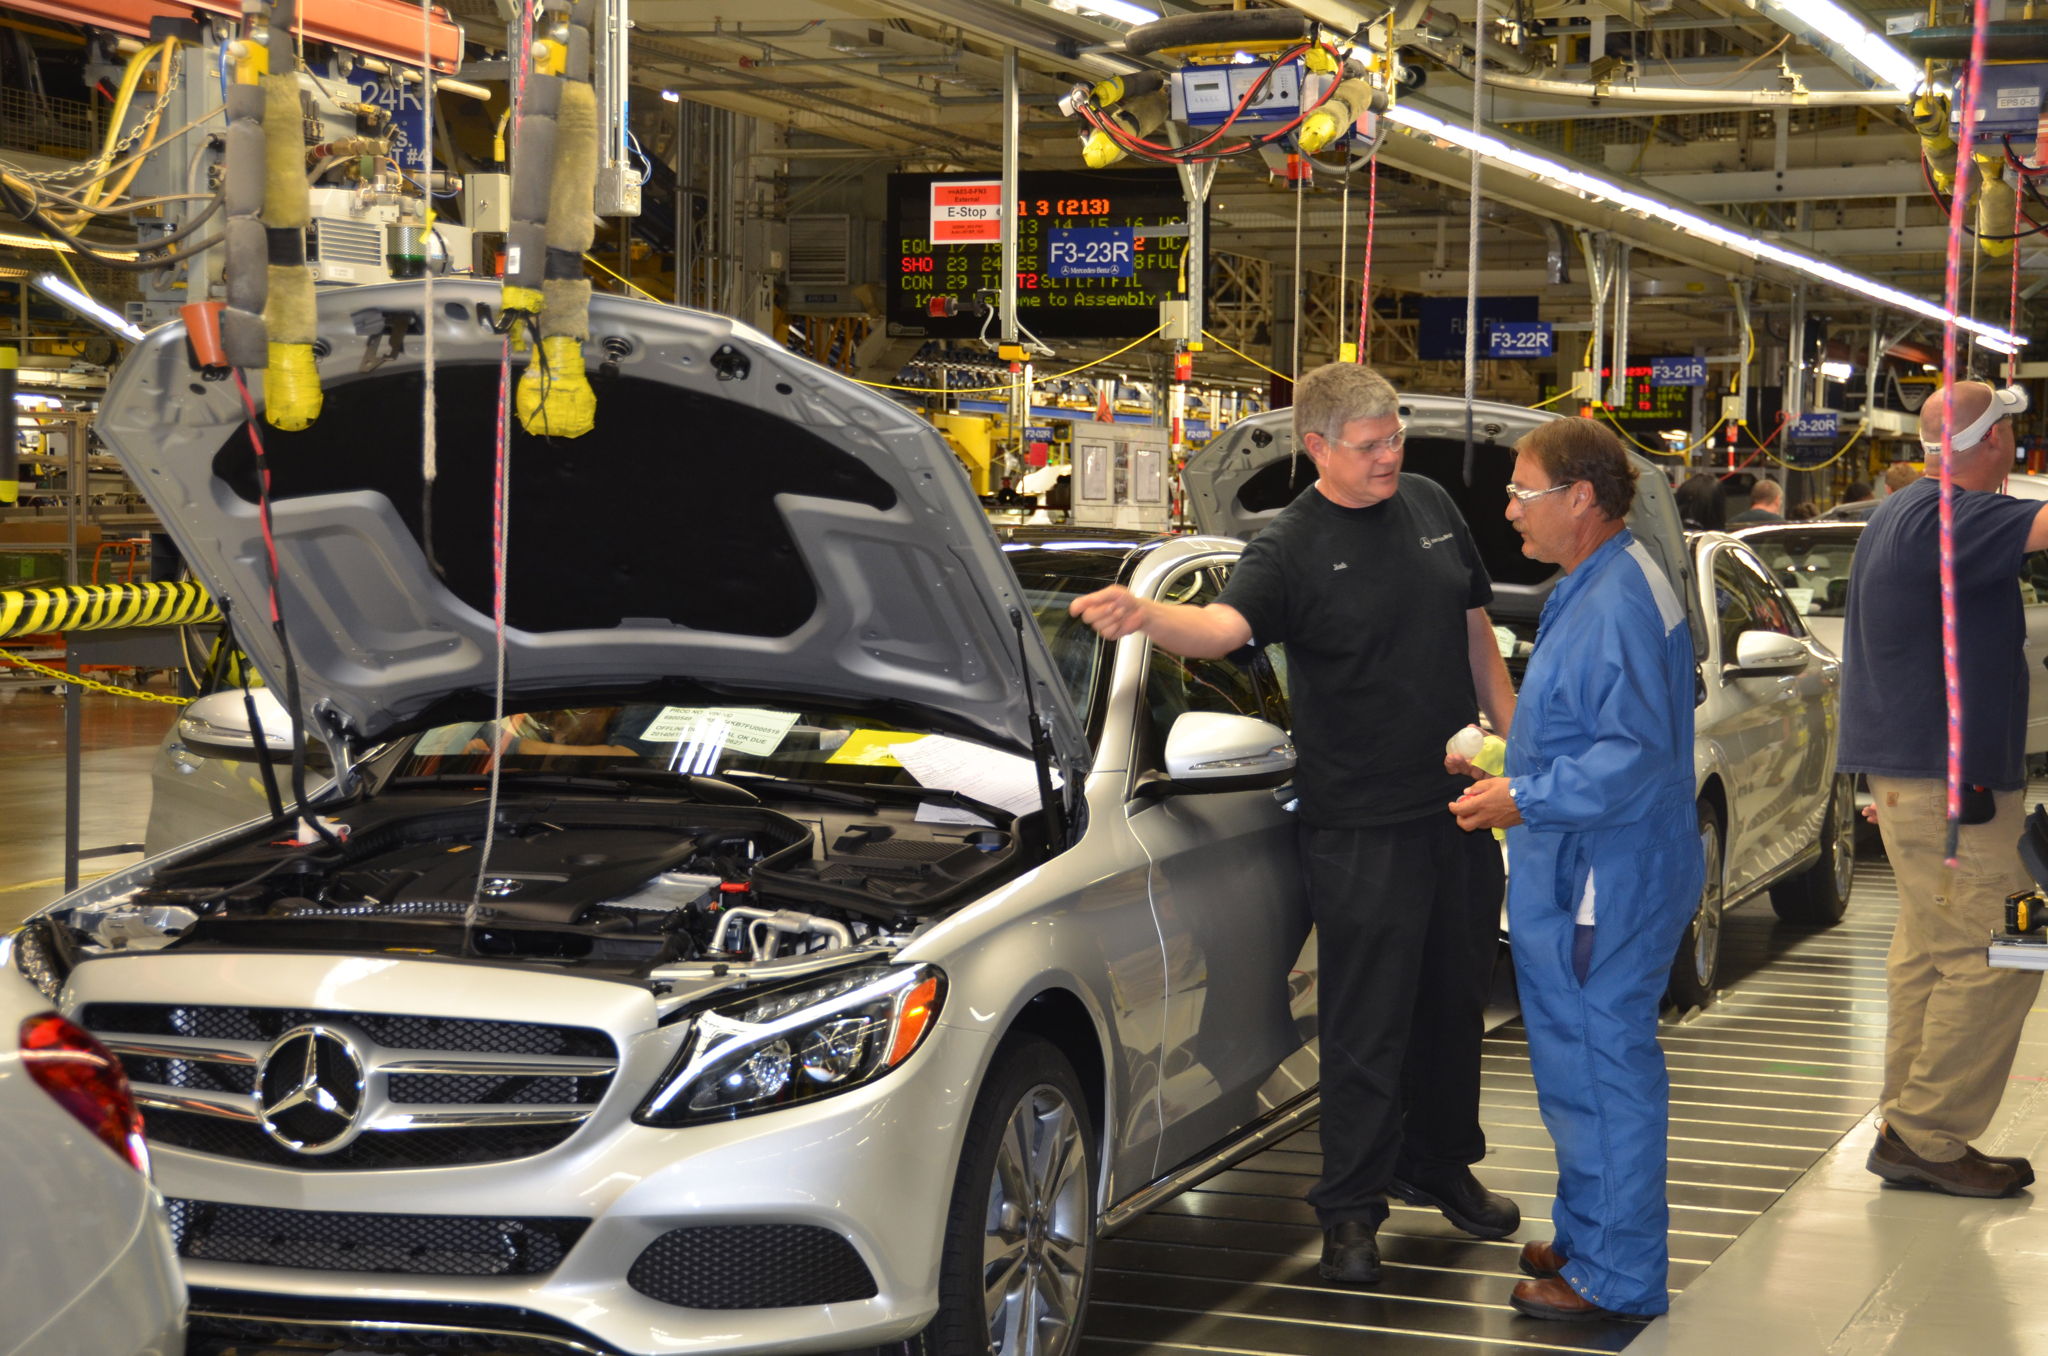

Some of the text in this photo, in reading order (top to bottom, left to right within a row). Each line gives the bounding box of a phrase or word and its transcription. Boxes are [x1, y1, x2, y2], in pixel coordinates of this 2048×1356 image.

[947, 206, 987, 219] E-Stop
[1036, 200, 1049, 215] 3
[1057, 199, 1110, 215] (213)
[1018, 218, 1039, 234] 13
[1018, 237, 1038, 252] 19
[1050, 242, 1130, 263] F3-23R
[946, 256, 968, 272] 23
[981, 256, 1002, 272] 24
[1017, 256, 1038, 271] 25
[902, 275, 933, 290] CON
[946, 274, 968, 290] 29
[1017, 273, 1039, 289] T2
[1048, 292, 1067, 306] to
[1074, 291, 1156, 306] Assembly
[1491, 332, 1549, 348] F3-22R
[1652, 364, 1703, 379] F3-21R
